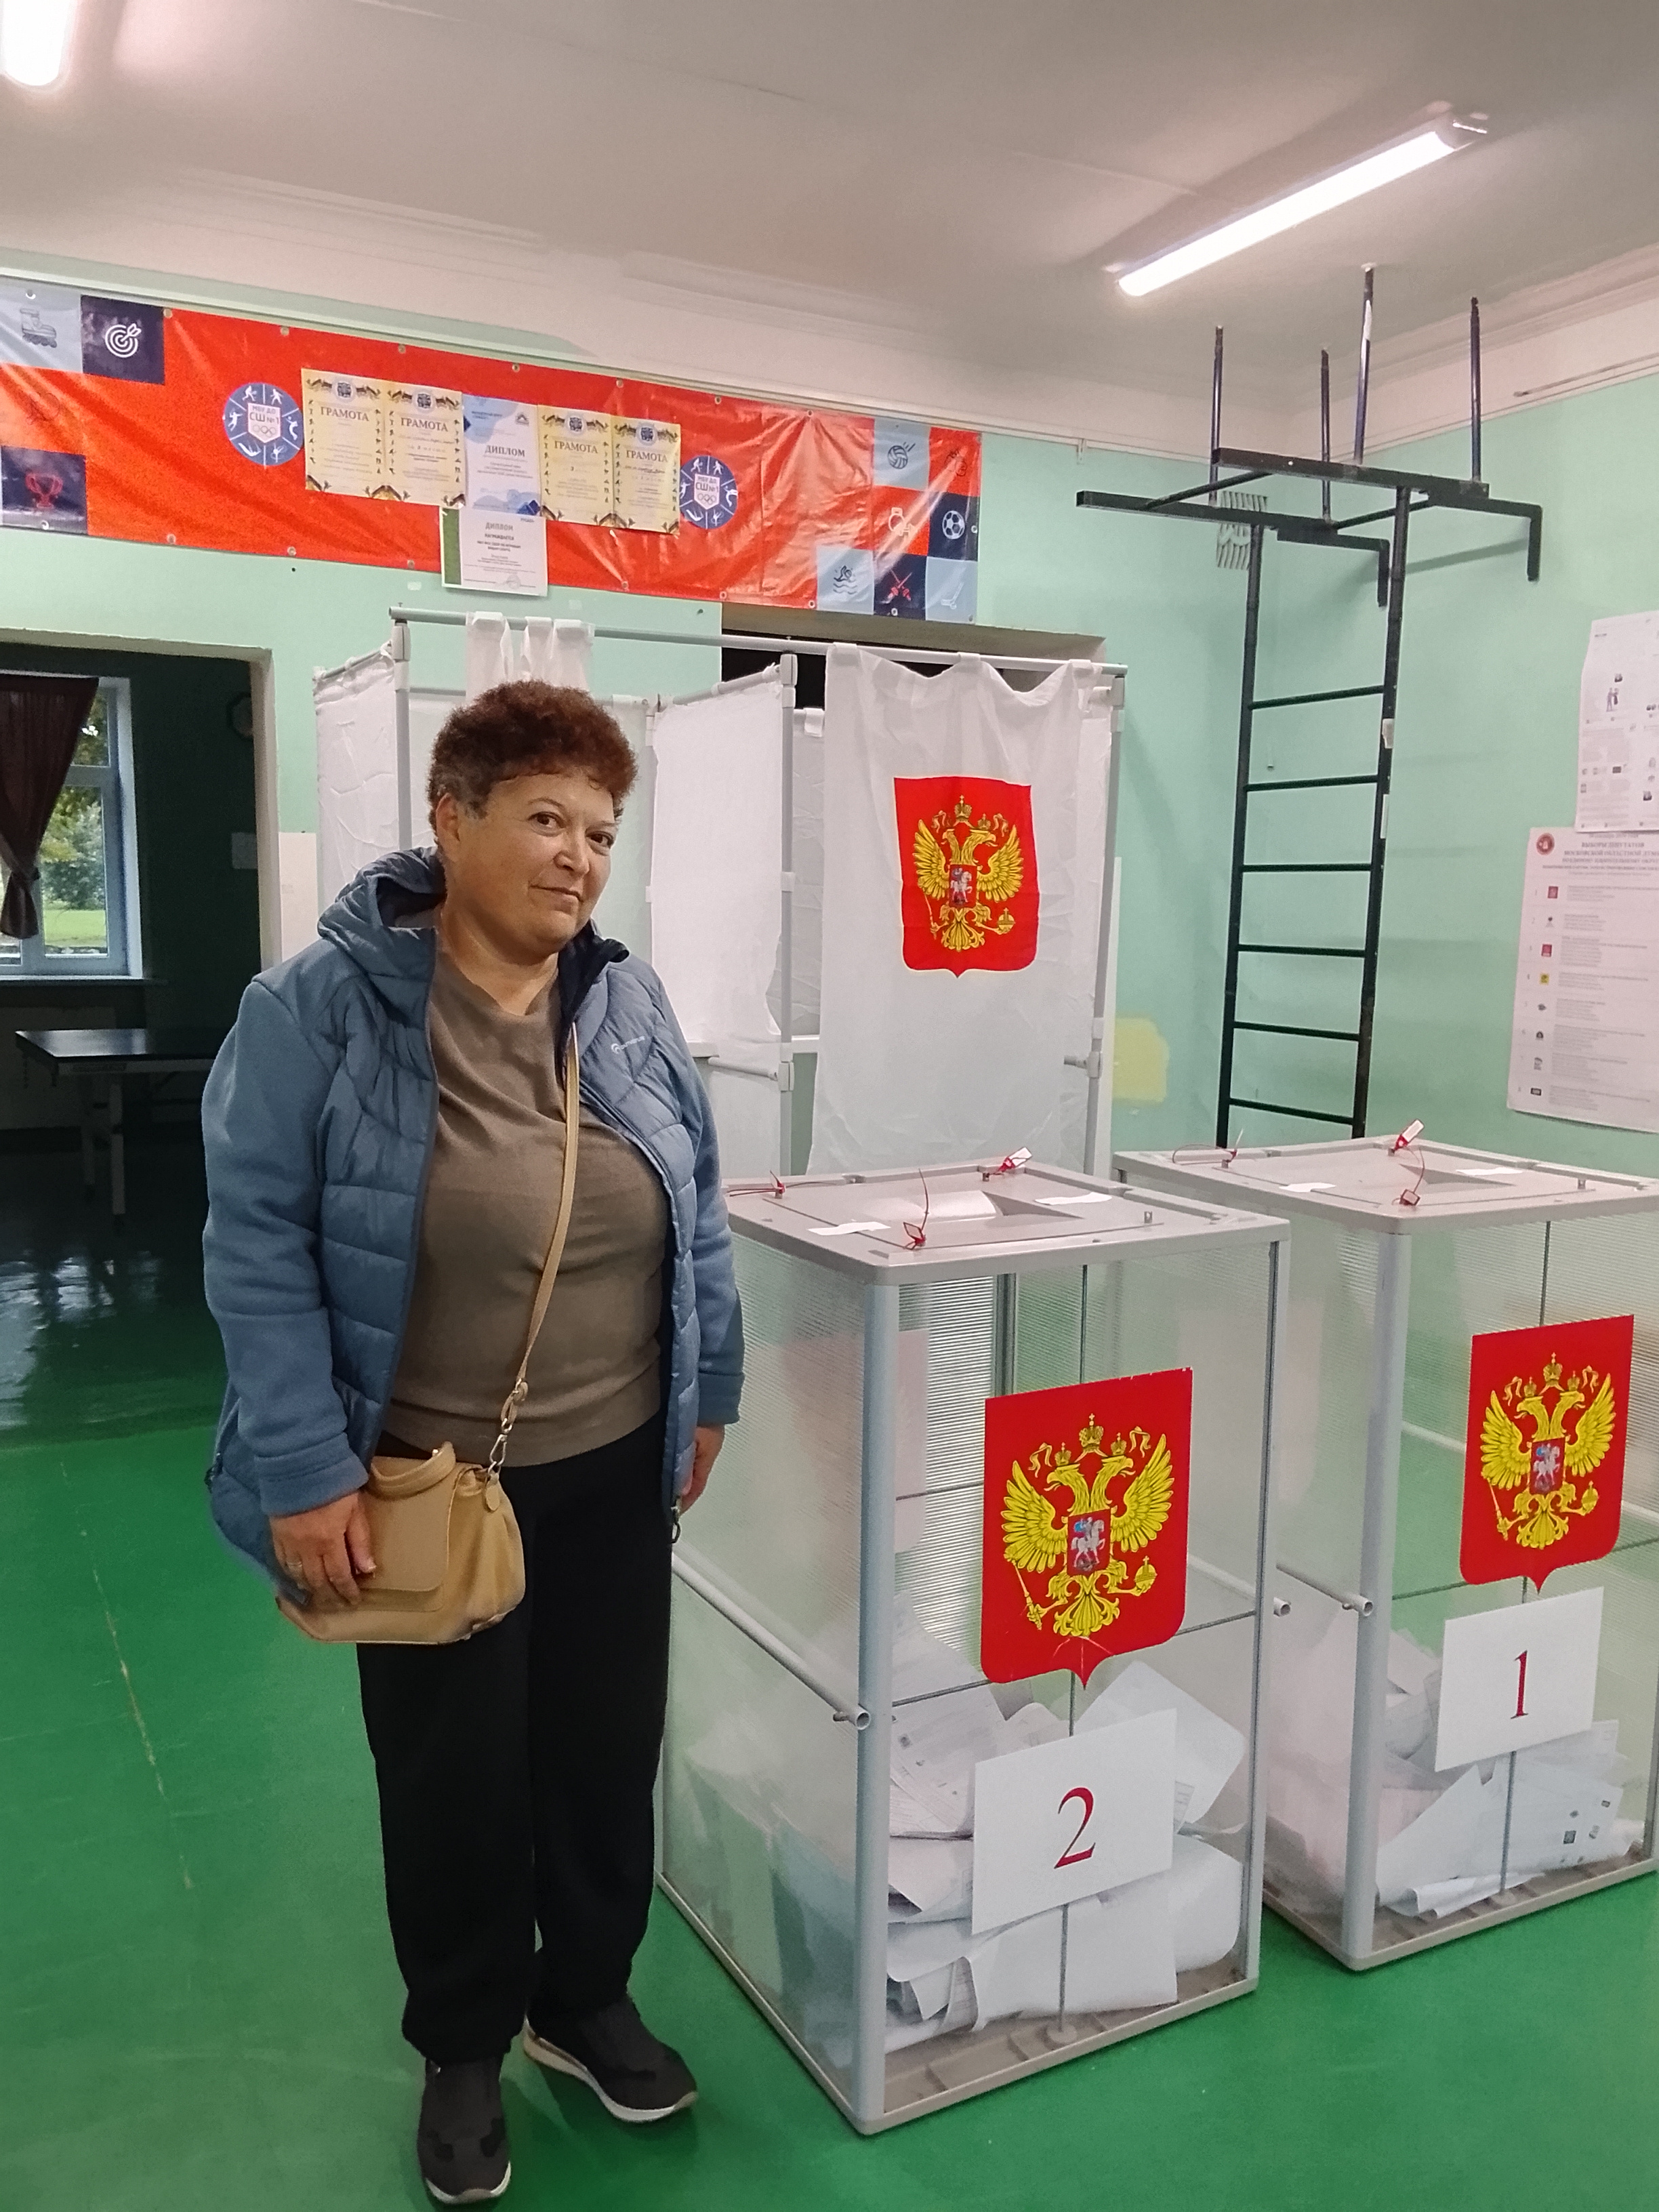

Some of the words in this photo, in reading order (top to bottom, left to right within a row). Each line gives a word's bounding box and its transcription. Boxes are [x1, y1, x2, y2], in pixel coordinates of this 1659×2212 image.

[249, 411, 266, 422] СШ
[320, 406, 369, 422] ГРАМОТА
[401, 417, 449, 432] ГРАМОТА
[485, 445, 525, 457] ДИПЛОМ
[554, 441, 599, 454] ГРАМОТА
[626, 449, 668, 463] ГРАМОТА
[695, 482, 709, 491] СШ
[485, 521, 514, 531] ДИПЛОМ
[1511, 1650, 1528, 1718] 1
[1055, 1786, 1095, 1869] 2
